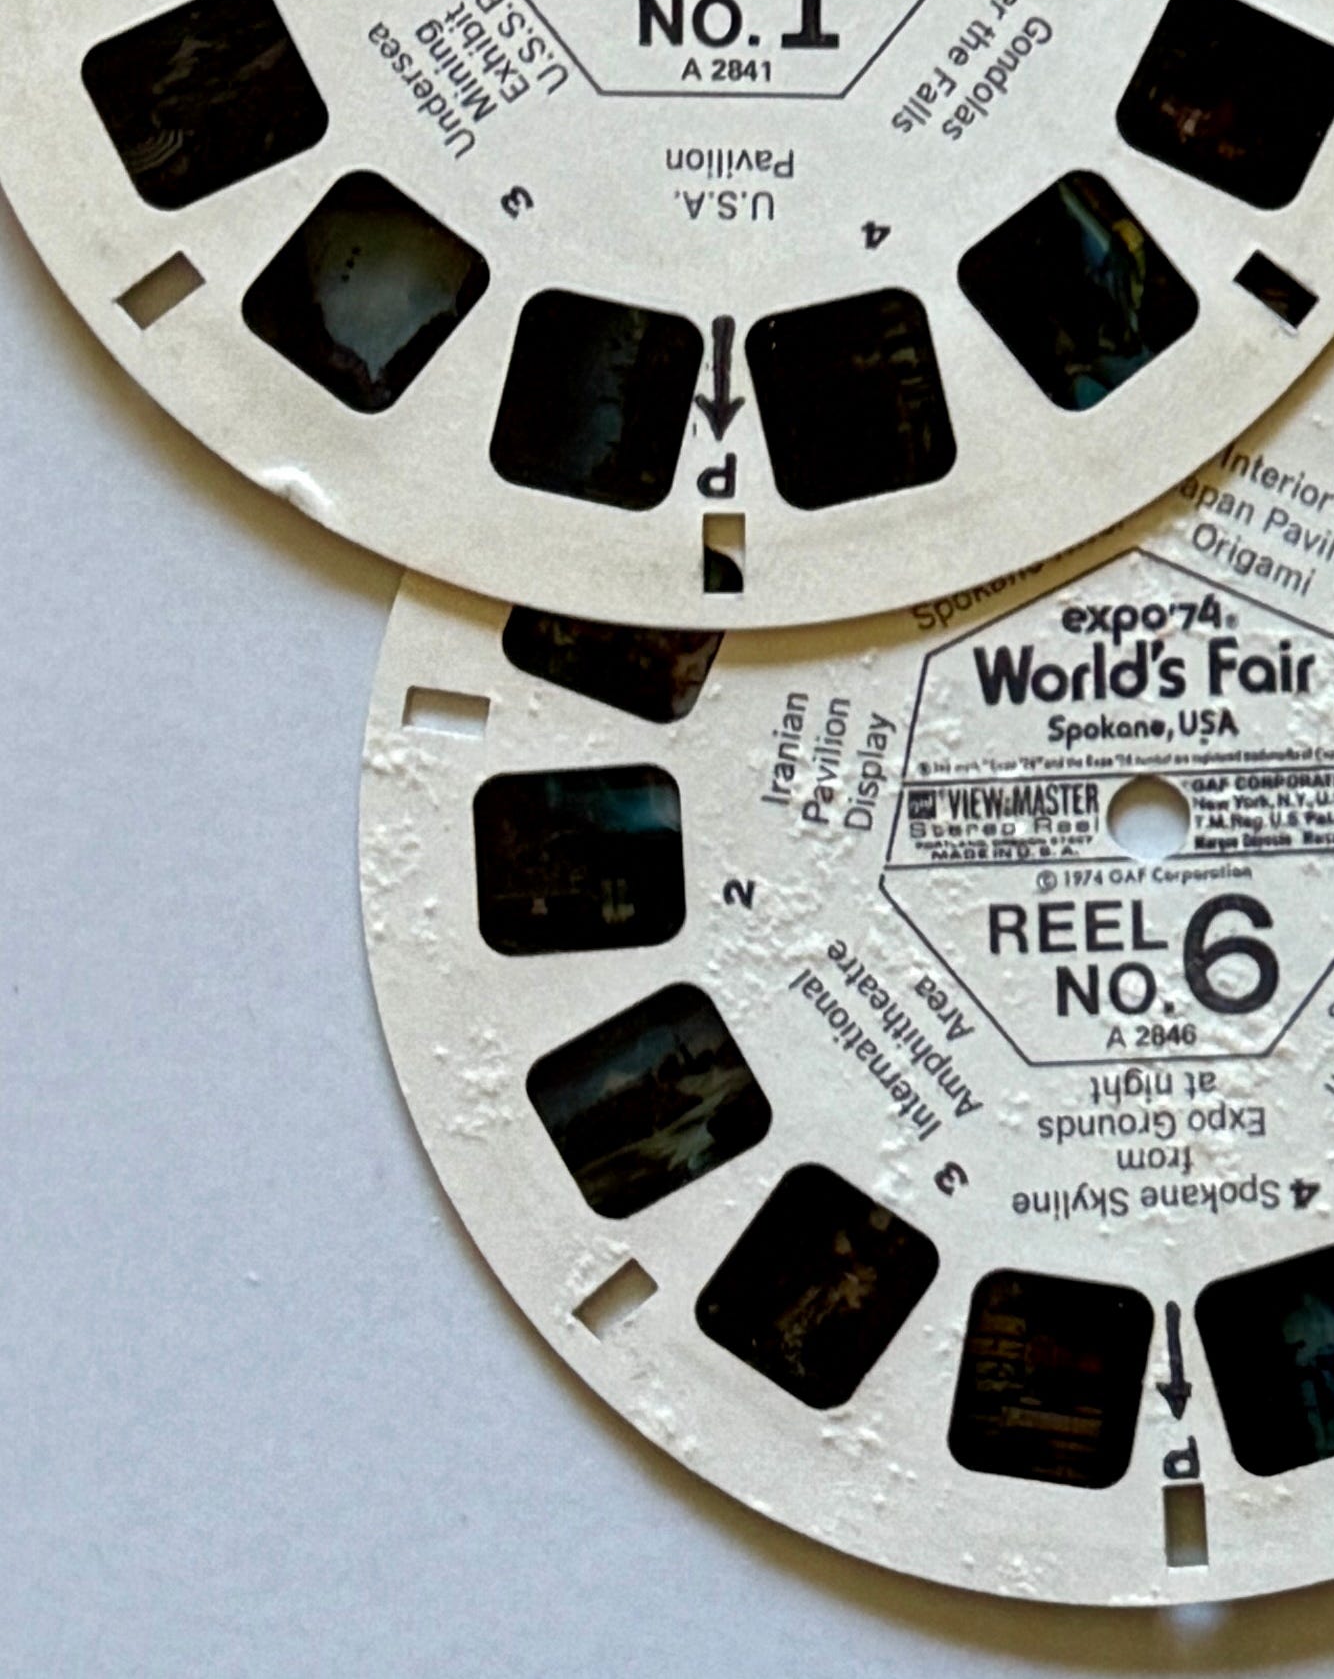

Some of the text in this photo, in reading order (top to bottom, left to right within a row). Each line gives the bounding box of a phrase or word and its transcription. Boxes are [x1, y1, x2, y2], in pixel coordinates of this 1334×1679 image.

[947, 19, 995, 66] the
[682, 58, 770, 81] A 2841
[941, 16, 1052, 140] Gondolas
[891, 66, 957, 133] Falls
[1176, 474, 1256, 525] apan
[1191, 522, 1315, 596] Origami
[973, 636, 1314, 705] World's Fair
[1048, 709, 1238, 749] Spokane, USA
[989, 900, 1168, 954] REEL
[1056, 893, 1279, 1016] NO. 6
[1107, 1024, 1195, 1047] A 2846
[1090, 1066, 1220, 1109] at night
[1037, 1100, 1265, 1145] Expo Grounds
[1116, 1145, 1193, 1176] from
[1011, 1173, 1280, 1220] Spokane Skyline
[1289, 1178, 1321, 1210] 4
